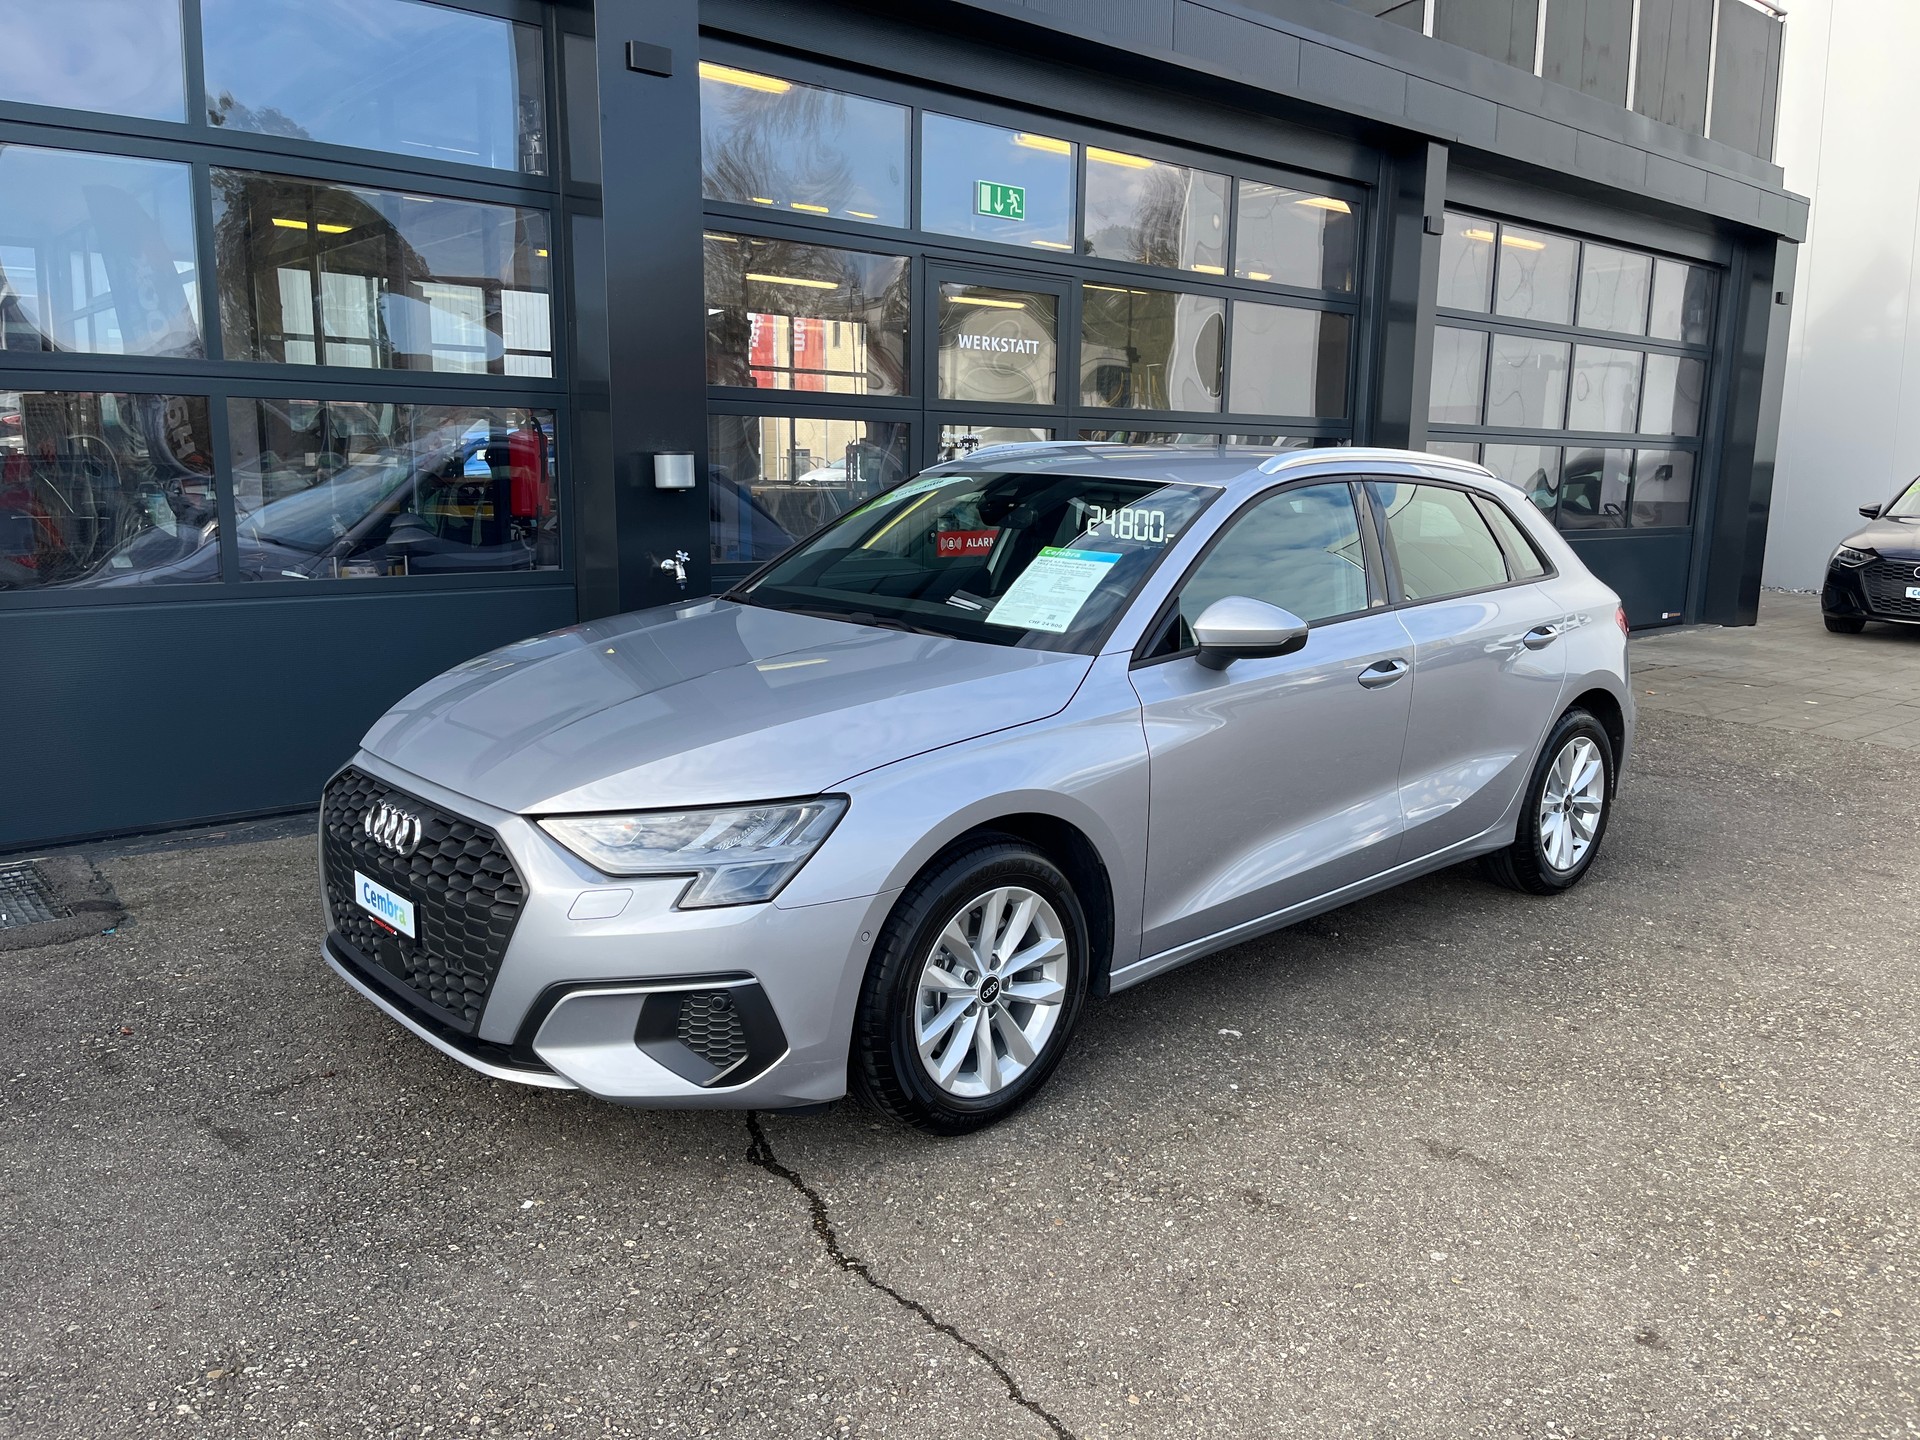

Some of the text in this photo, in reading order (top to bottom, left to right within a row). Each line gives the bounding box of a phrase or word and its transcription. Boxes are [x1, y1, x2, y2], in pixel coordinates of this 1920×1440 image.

[958, 333, 1039, 354] WERKSTATT
[1044, 549, 1081, 558] Cembra
[363, 881, 407, 926] Cembra
